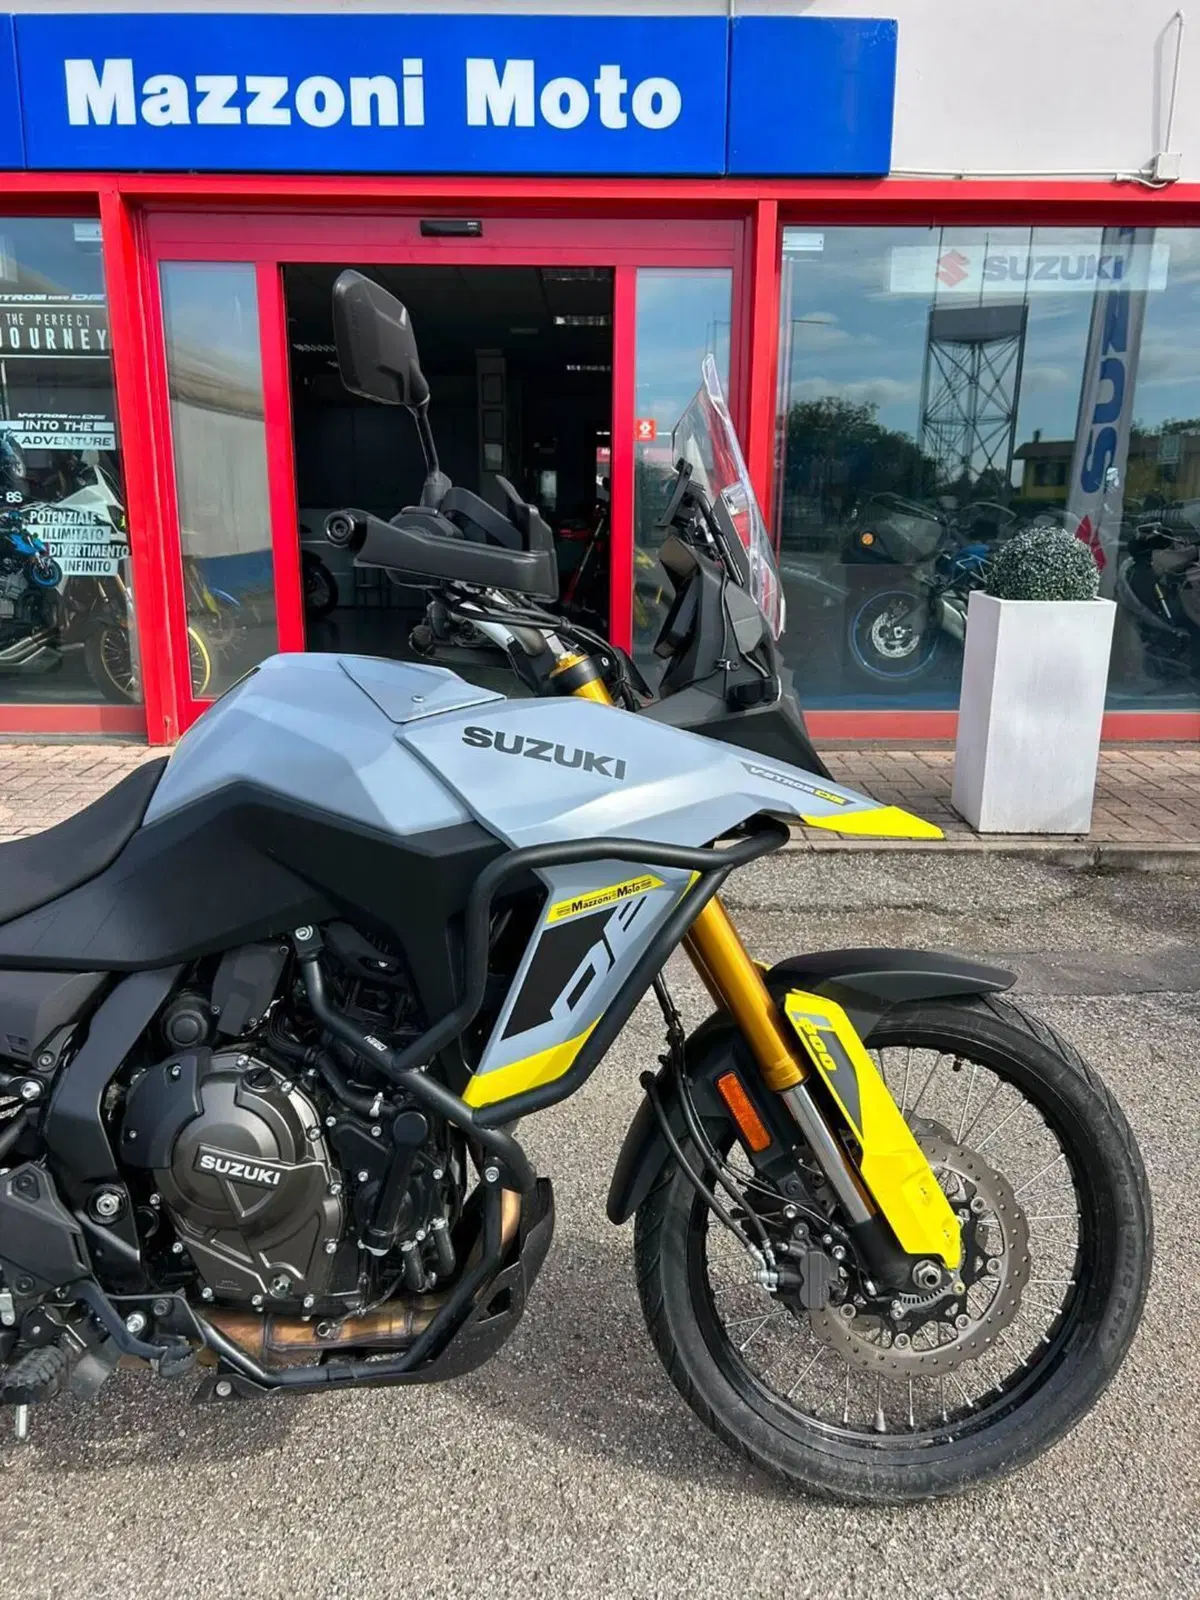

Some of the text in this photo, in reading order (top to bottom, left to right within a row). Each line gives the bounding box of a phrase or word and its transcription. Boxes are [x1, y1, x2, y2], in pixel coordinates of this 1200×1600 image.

[64, 58, 682, 129] Mazzoni Moto
[982, 255, 1124, 281] SUZUKI
[6, 313, 91, 327] THE PERFECT
[0, 327, 107, 351] OURNEY
[25, 420, 94, 432] INTO THE
[22, 436, 112, 447] ADVENTURE
[29, 510, 97, 525] POTENZIALE
[42, 527, 104, 541] ILLIMITATO
[49, 544, 130, 558] DIVERTIMENTO
[63, 559, 112, 573] INFINITO
[461, 725, 627, 780] SUZUKI
[750, 766, 816, 794] V-STROM
[571, 894, 612, 912] Mazzoni
[617, 882, 641, 898] Moto
[200, 1155, 281, 1186] SUZUKI
